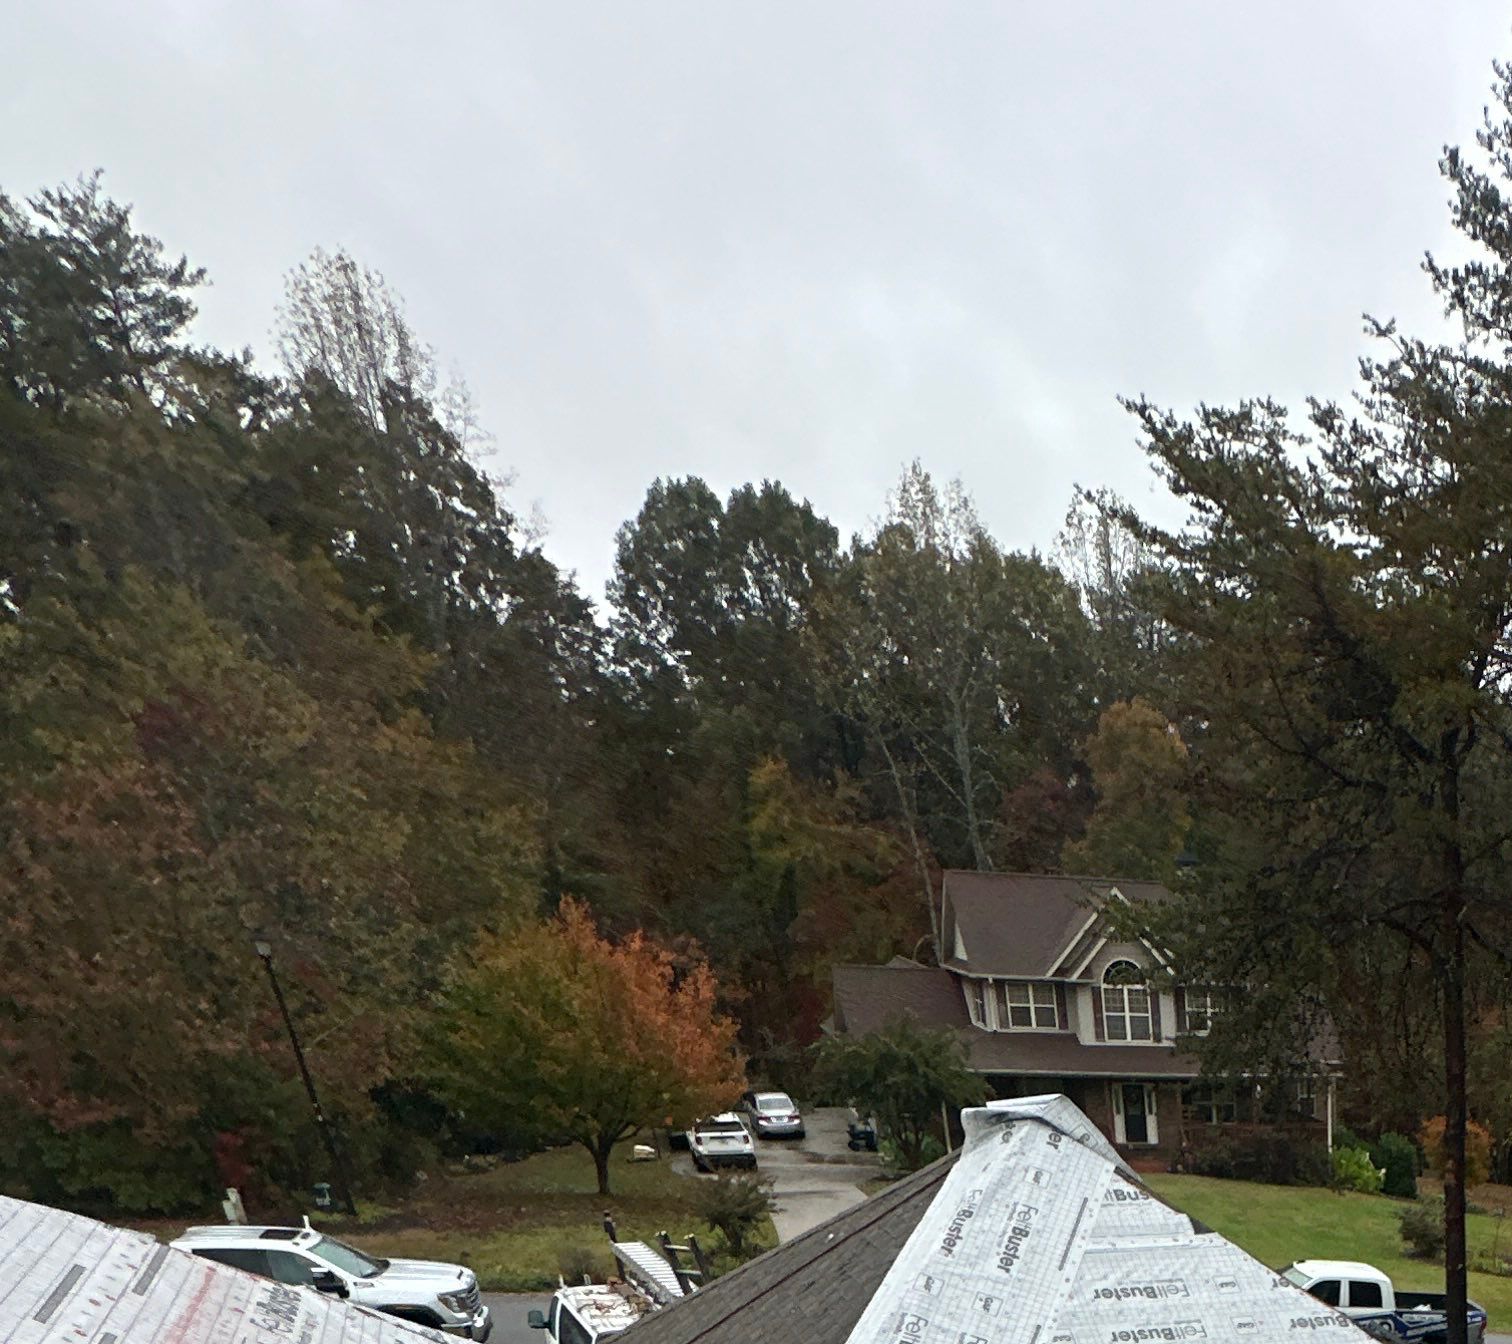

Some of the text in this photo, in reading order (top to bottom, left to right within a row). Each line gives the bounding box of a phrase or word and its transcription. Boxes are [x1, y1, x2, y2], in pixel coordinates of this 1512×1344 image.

[998, 1204, 1039, 1274] FeltBuster
[1093, 1281, 1191, 1299] FeltBuster
[1290, 1314, 1352, 1330] Buster
[1111, 1324, 1208, 1344] FeltBuster
